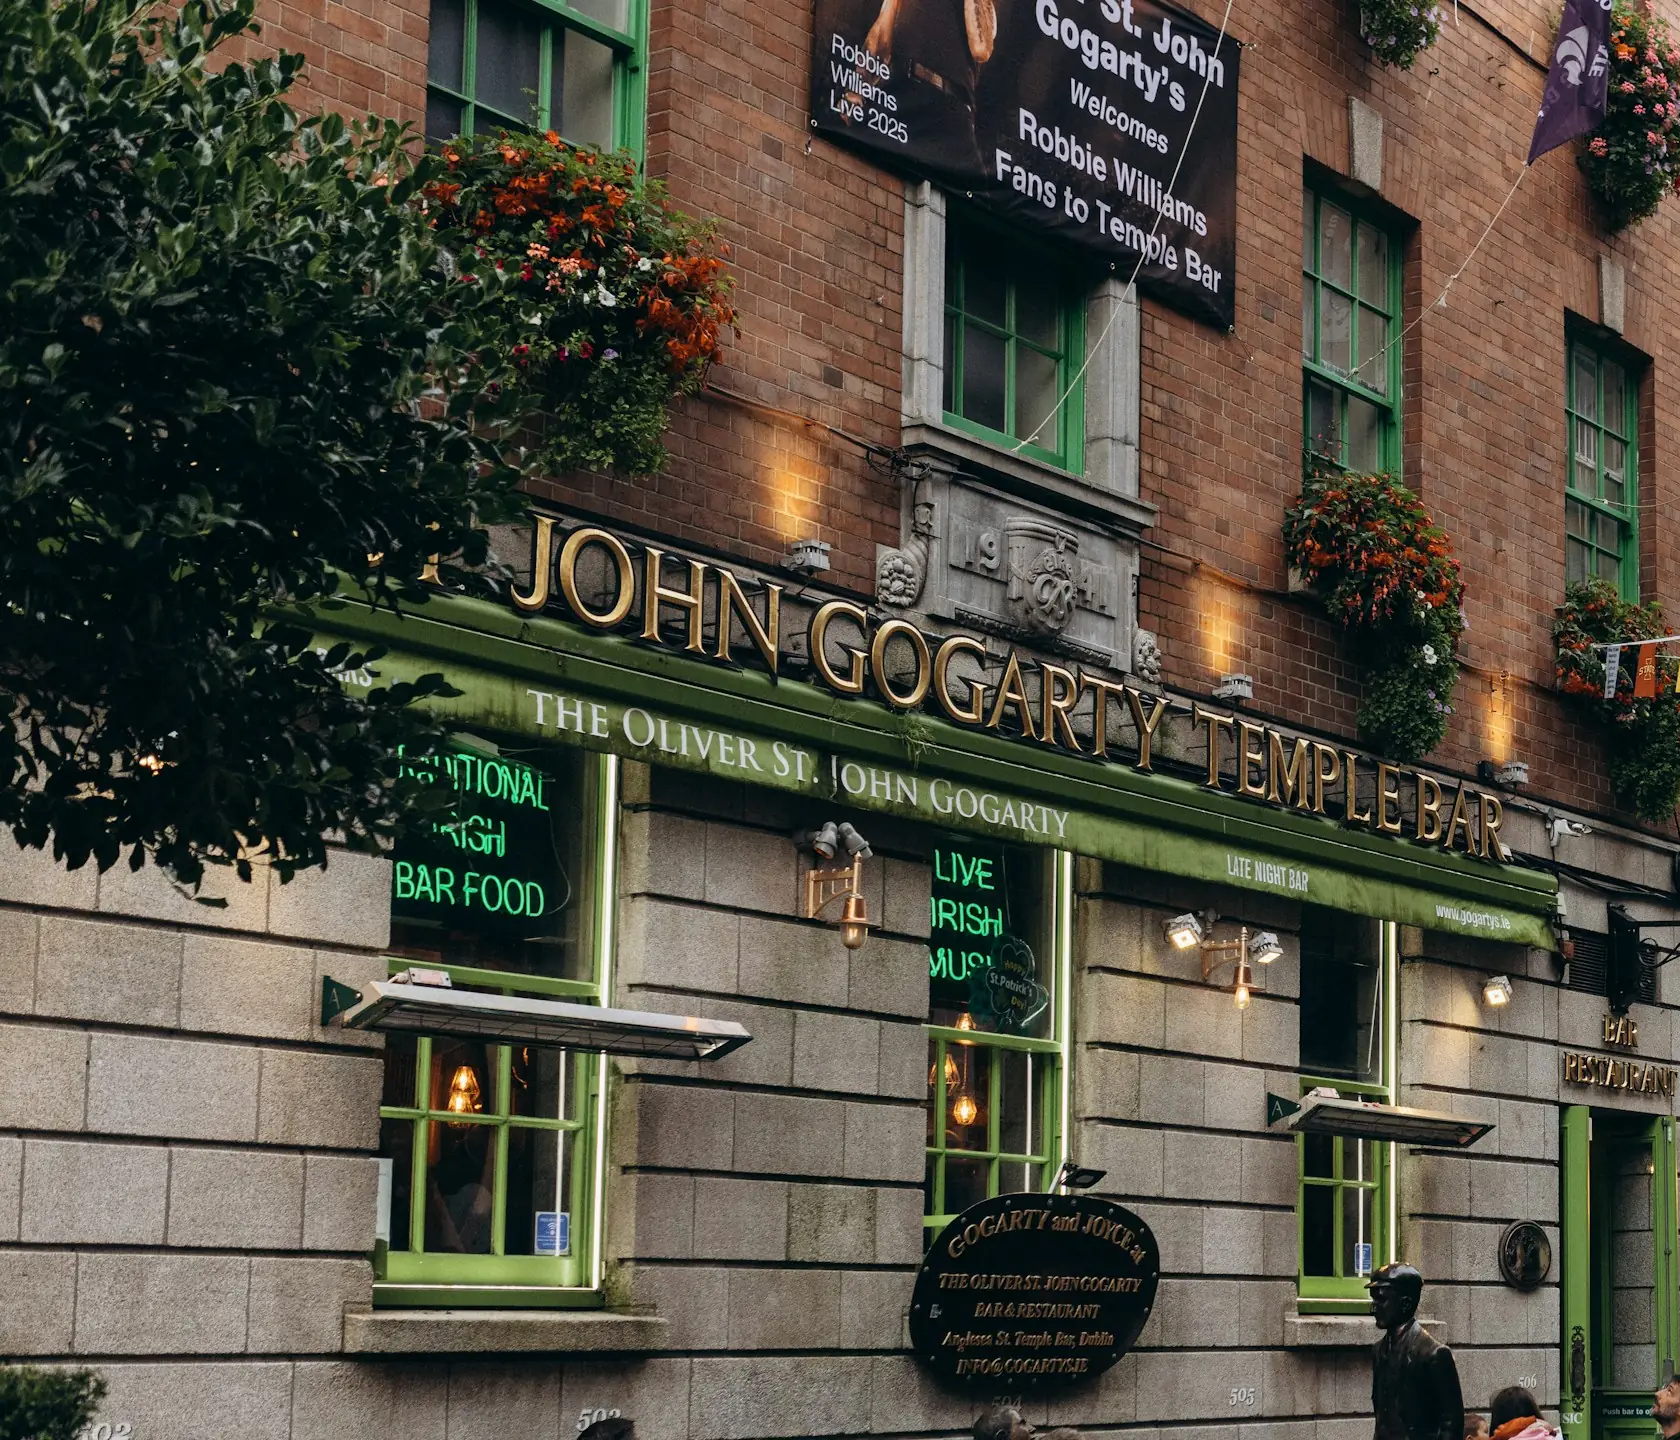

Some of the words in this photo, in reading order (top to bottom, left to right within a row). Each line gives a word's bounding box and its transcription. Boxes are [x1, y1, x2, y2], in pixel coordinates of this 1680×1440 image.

[831, 33, 891, 81] Robbie
[1035, 0, 1187, 112] Gogarty's
[1153, 19, 1226, 88] John
[830, 62, 898, 112] Williams
[829, 94, 863, 122] Live
[868, 109, 909, 144] 2025
[1069, 77, 1169, 155] Welcomes
[1018, 107, 1107, 182] Robbie
[1113, 157, 1208, 237] Williams
[995, 148, 1057, 210] Fans
[1064, 184, 1088, 225] to
[1096, 199, 1179, 271] Temple
[1186, 247, 1222, 294] Bar
[511, 512, 781, 678] JOHN
[810, 602, 1168, 770] GOGARTY
[1193, 705, 1400, 833] TEMPLE
[1416, 772, 1506, 861] BAR
[527, 689, 610, 739] THE
[623, 707, 762, 772] OLIVER
[772, 740, 818, 785] ST.
[831, 754, 917, 806] JOHN
[931, 777, 1070, 838] GOGARTY
[396, 861, 455, 905] BAR
[464, 872, 544, 917] FOOD
[935, 849, 995, 890] LIVE
[1226, 854, 1252, 881] LATE
[1254, 861, 1287, 887] NIGHT
[1288, 868, 1310, 893] BAR
[930, 897, 1003, 937] IRISH
[1435, 903, 1511, 932] www.gogartys.ie
[1602, 1014, 1638, 1048] BAR
[1563, 1051, 1678, 1098] RESTAURANT
[1271, 1100, 1284, 1117] A
[947, 1209, 1050, 1259] GOGARTY
[1052, 1212, 1081, 1232] and
[1082, 1214, 1136, 1251] JOYCE
[1130, 1244, 1147, 1266] at
[939, 1273, 969, 1289] THE
[970, 1274, 1022, 1290] OLIVER
[1043, 1276, 1080, 1292] JOHN
[1081, 1277, 1143, 1293] GOGARTY
[974, 1302, 1003, 1318] BAR
[1004, 1304, 1016, 1317] &
[1016, 1303, 1101, 1319] RESTAURANT
[941, 1331, 992, 1352] Anglesea
[995, 1331, 1011, 1346] St.
[1015, 1332, 1052, 1350] Temple
[1054, 1333, 1076, 1348] Bar,
[1079, 1332, 1114, 1347] Dublin
[1229, 1389, 1255, 1407] 505
[1602, 1408, 1620, 1416] Push
[1622, 1408, 1634, 1416] bar
[1636, 1408, 1643, 1416] to
